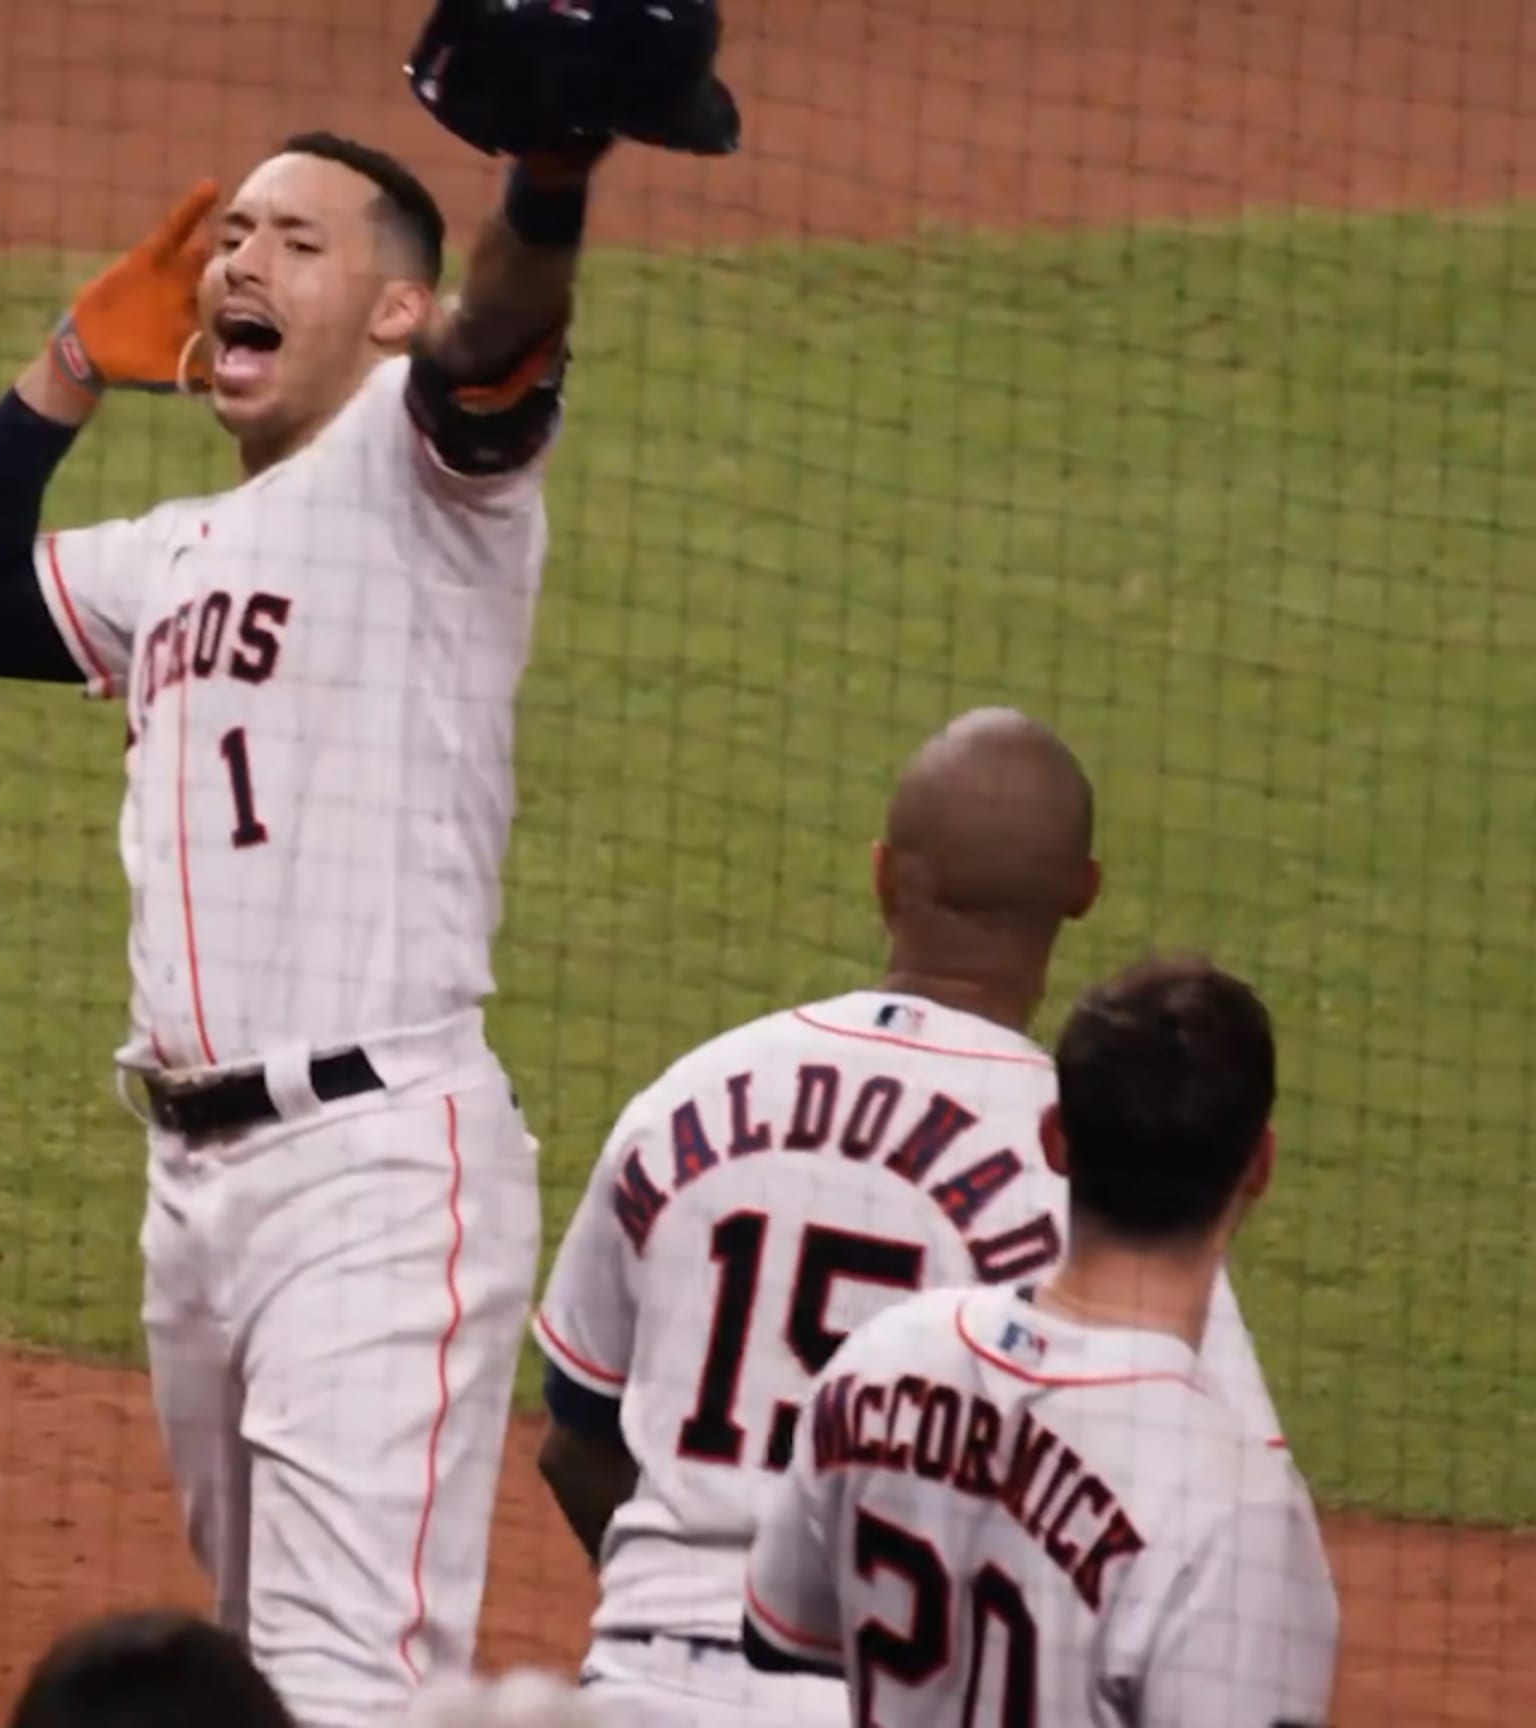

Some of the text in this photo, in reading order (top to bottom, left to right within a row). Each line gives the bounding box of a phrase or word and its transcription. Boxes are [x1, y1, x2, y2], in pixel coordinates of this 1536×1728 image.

[219, 727, 268, 849] 1
[612, 1063, 1063, 1304] MALDONAD
[675, 1208, 927, 1472] 15
[854, 1503, 1038, 1728] 20
